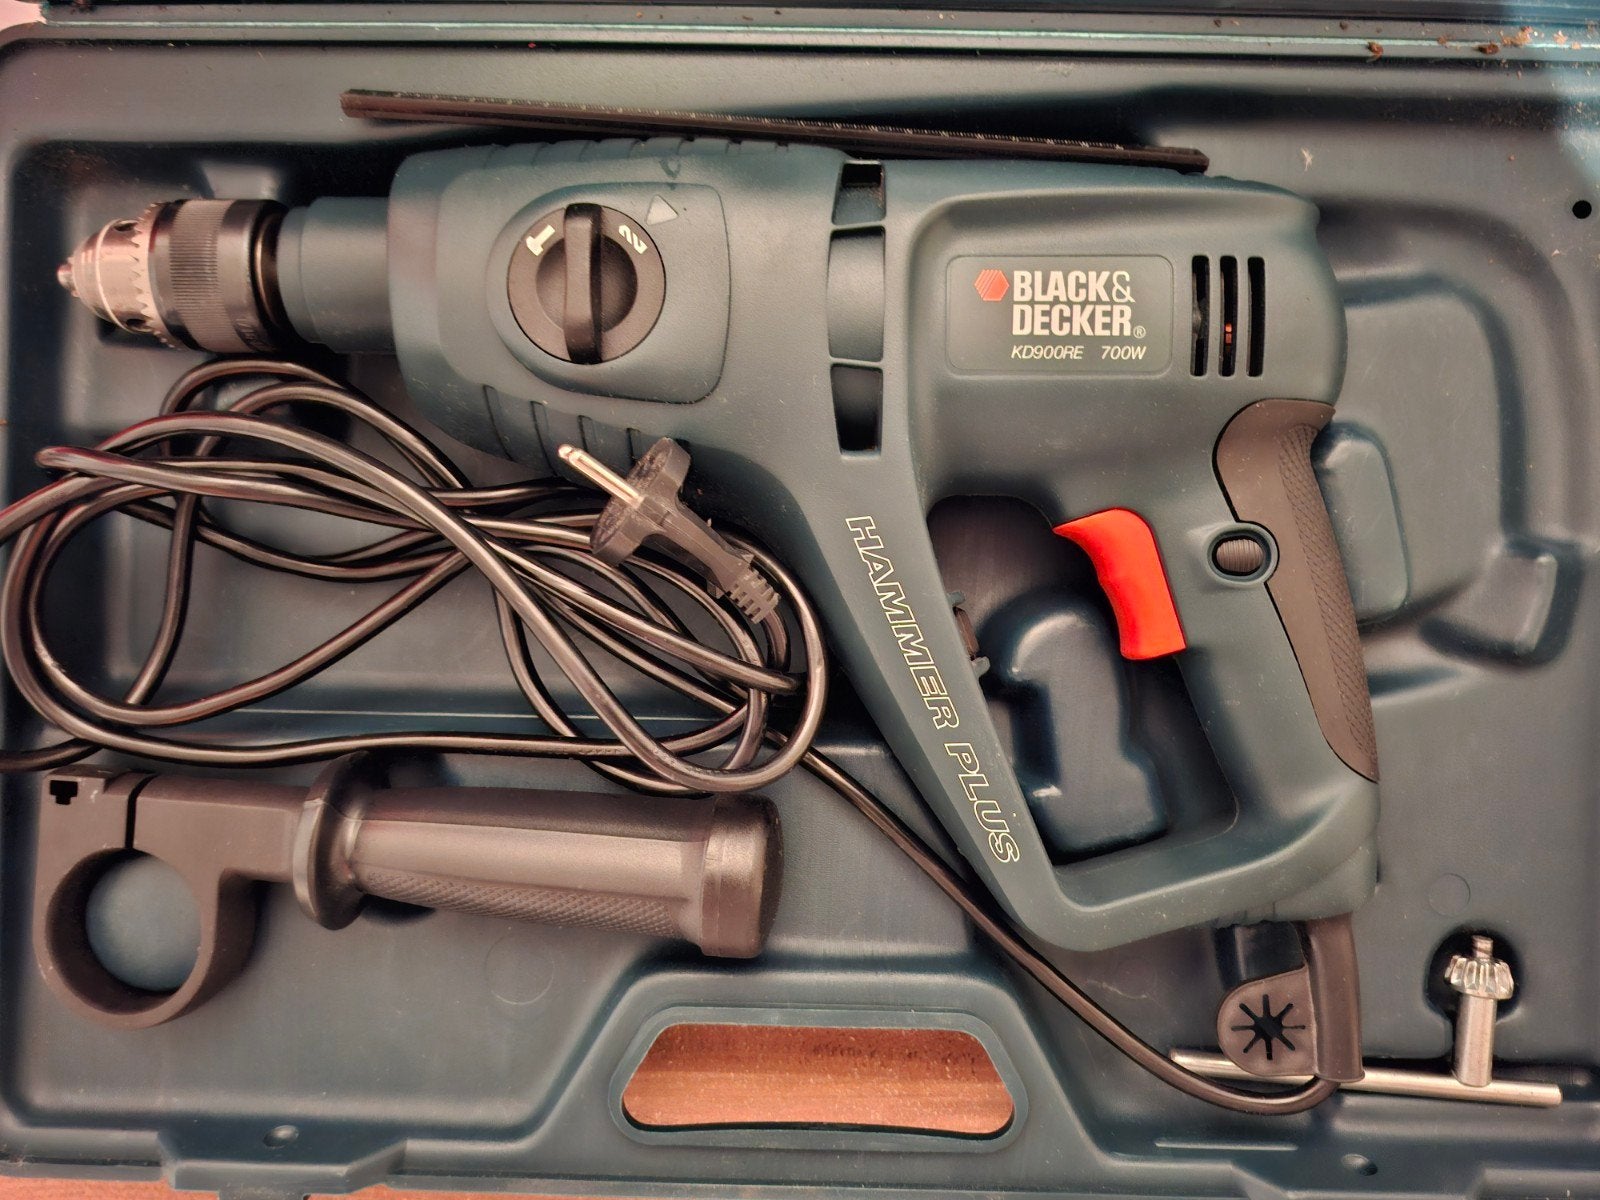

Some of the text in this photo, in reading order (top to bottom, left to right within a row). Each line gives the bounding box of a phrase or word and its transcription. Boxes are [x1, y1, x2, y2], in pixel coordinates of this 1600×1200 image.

[525, 224, 556, 257] 1
[618, 224, 649, 255] 2
[1012, 270, 1136, 303] BLACK&
[1010, 345, 1148, 360] KD900RE 700W
[845, 515, 1020, 864] HAMMER PLUS
